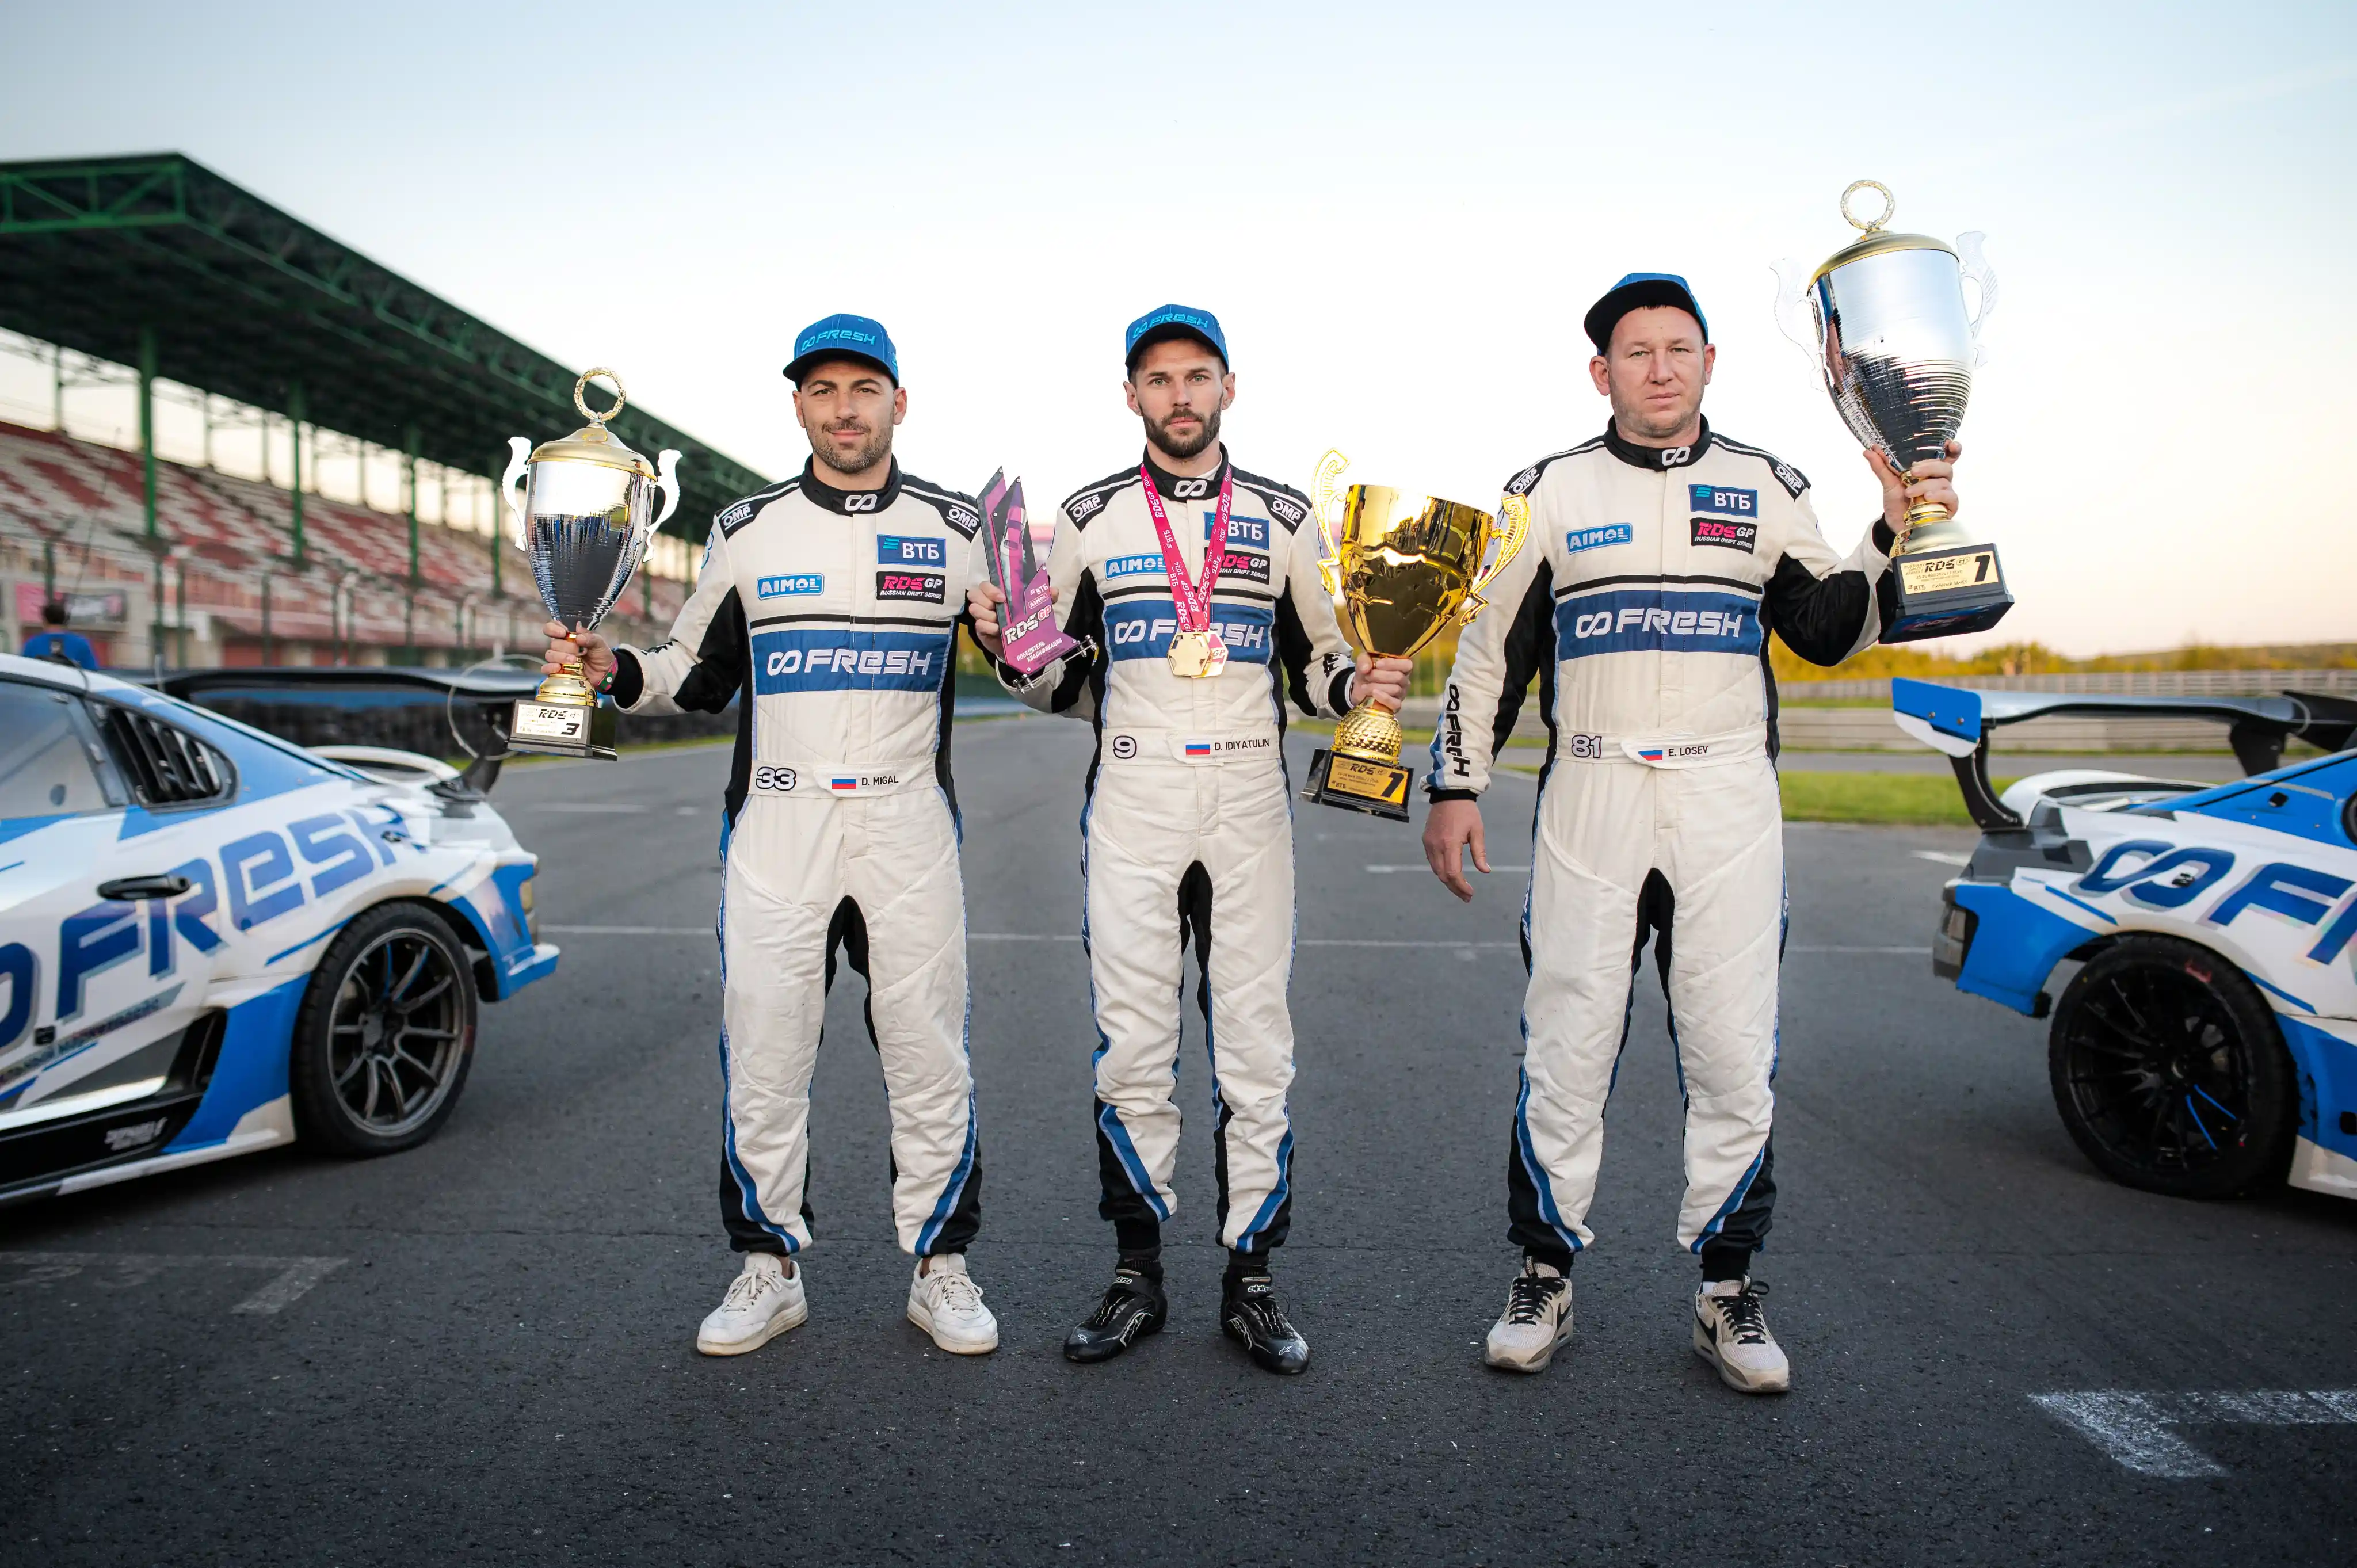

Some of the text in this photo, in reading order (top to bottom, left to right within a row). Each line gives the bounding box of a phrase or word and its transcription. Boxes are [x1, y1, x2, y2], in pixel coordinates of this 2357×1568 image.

[1513, 469, 1537, 493] OMP
[1777, 466, 1801, 489] OMP
[1073, 497, 1100, 519] OMP
[1272, 499, 1300, 521] OMP
[1714, 493, 1750, 509] ВТБ
[723, 506, 751, 526] OMP
[949, 508, 977, 528] OMP
[1228, 521, 1263, 540] ВТБ
[1569, 529, 1628, 549] AIMOL
[902, 543, 939, 560] ВТБ
[1736, 540, 1752, 549] SERIES
[1223, 555, 1251, 569] DS
[1250, 571, 1268, 579] SERIES
[760, 579, 820, 596] AIMOL
[1036, 583, 1048, 595] ВТБ
[1017, 641, 1046, 661] ПОБЕДИТЕЛЬ
[1027, 638, 1062, 662] КВАЛИФИКАЦИИ
[561, 722, 580, 735] 3
[1113, 735, 1137, 759] 9
[1215, 739, 1269, 750] D. IDIYATULIN
[1572, 735, 1602, 758] 81
[1668, 746, 1708, 757] E. LOSEV
[755, 766, 796, 791] 33
[861, 775, 899, 786] D. MIGAL
